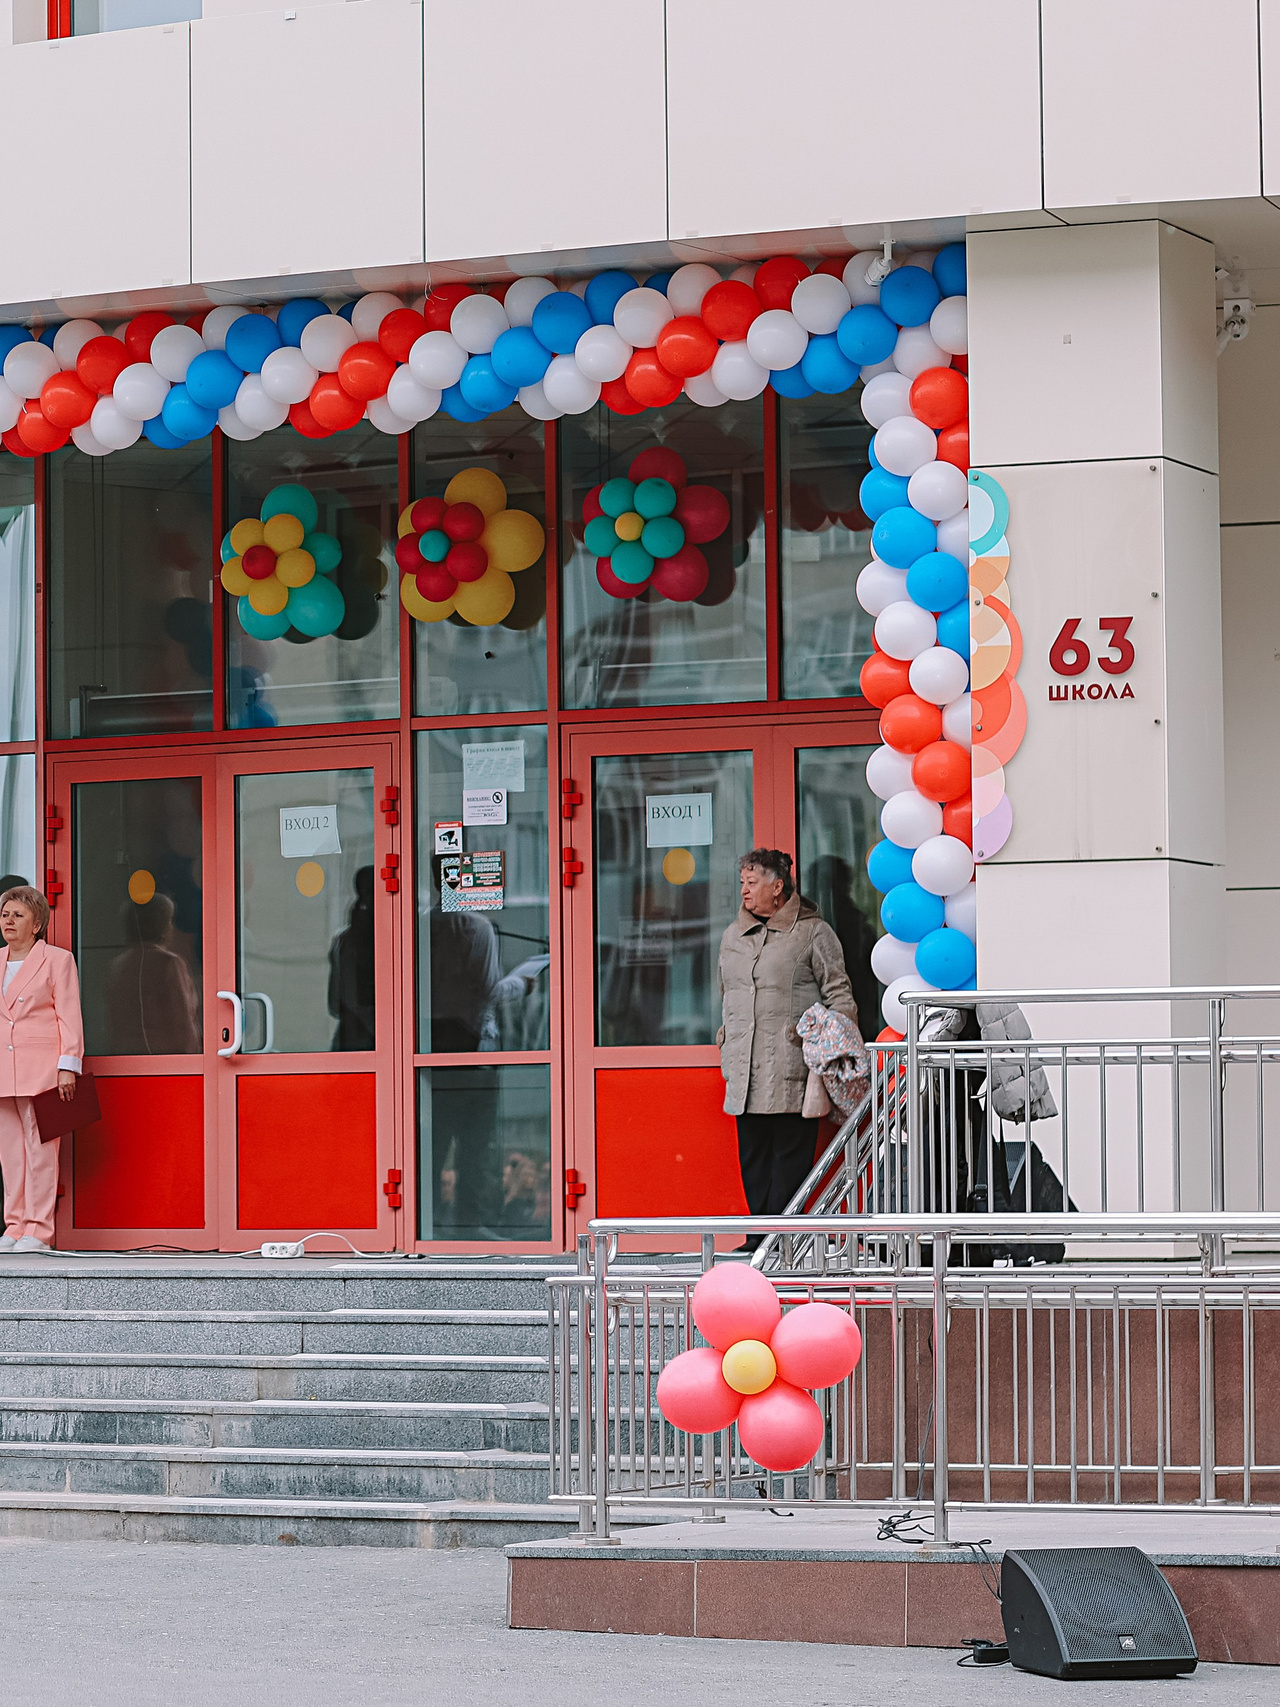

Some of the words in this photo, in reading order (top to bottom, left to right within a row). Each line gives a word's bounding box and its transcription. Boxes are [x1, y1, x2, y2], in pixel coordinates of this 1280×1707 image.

[1048, 616, 1135, 677] 63
[1048, 682, 1136, 701] ШКОЛА
[651, 805, 693, 820] ВХОД
[697, 804, 702, 817] 1
[284, 816, 321, 831] ВХОД
[322, 815, 330, 828] 2
